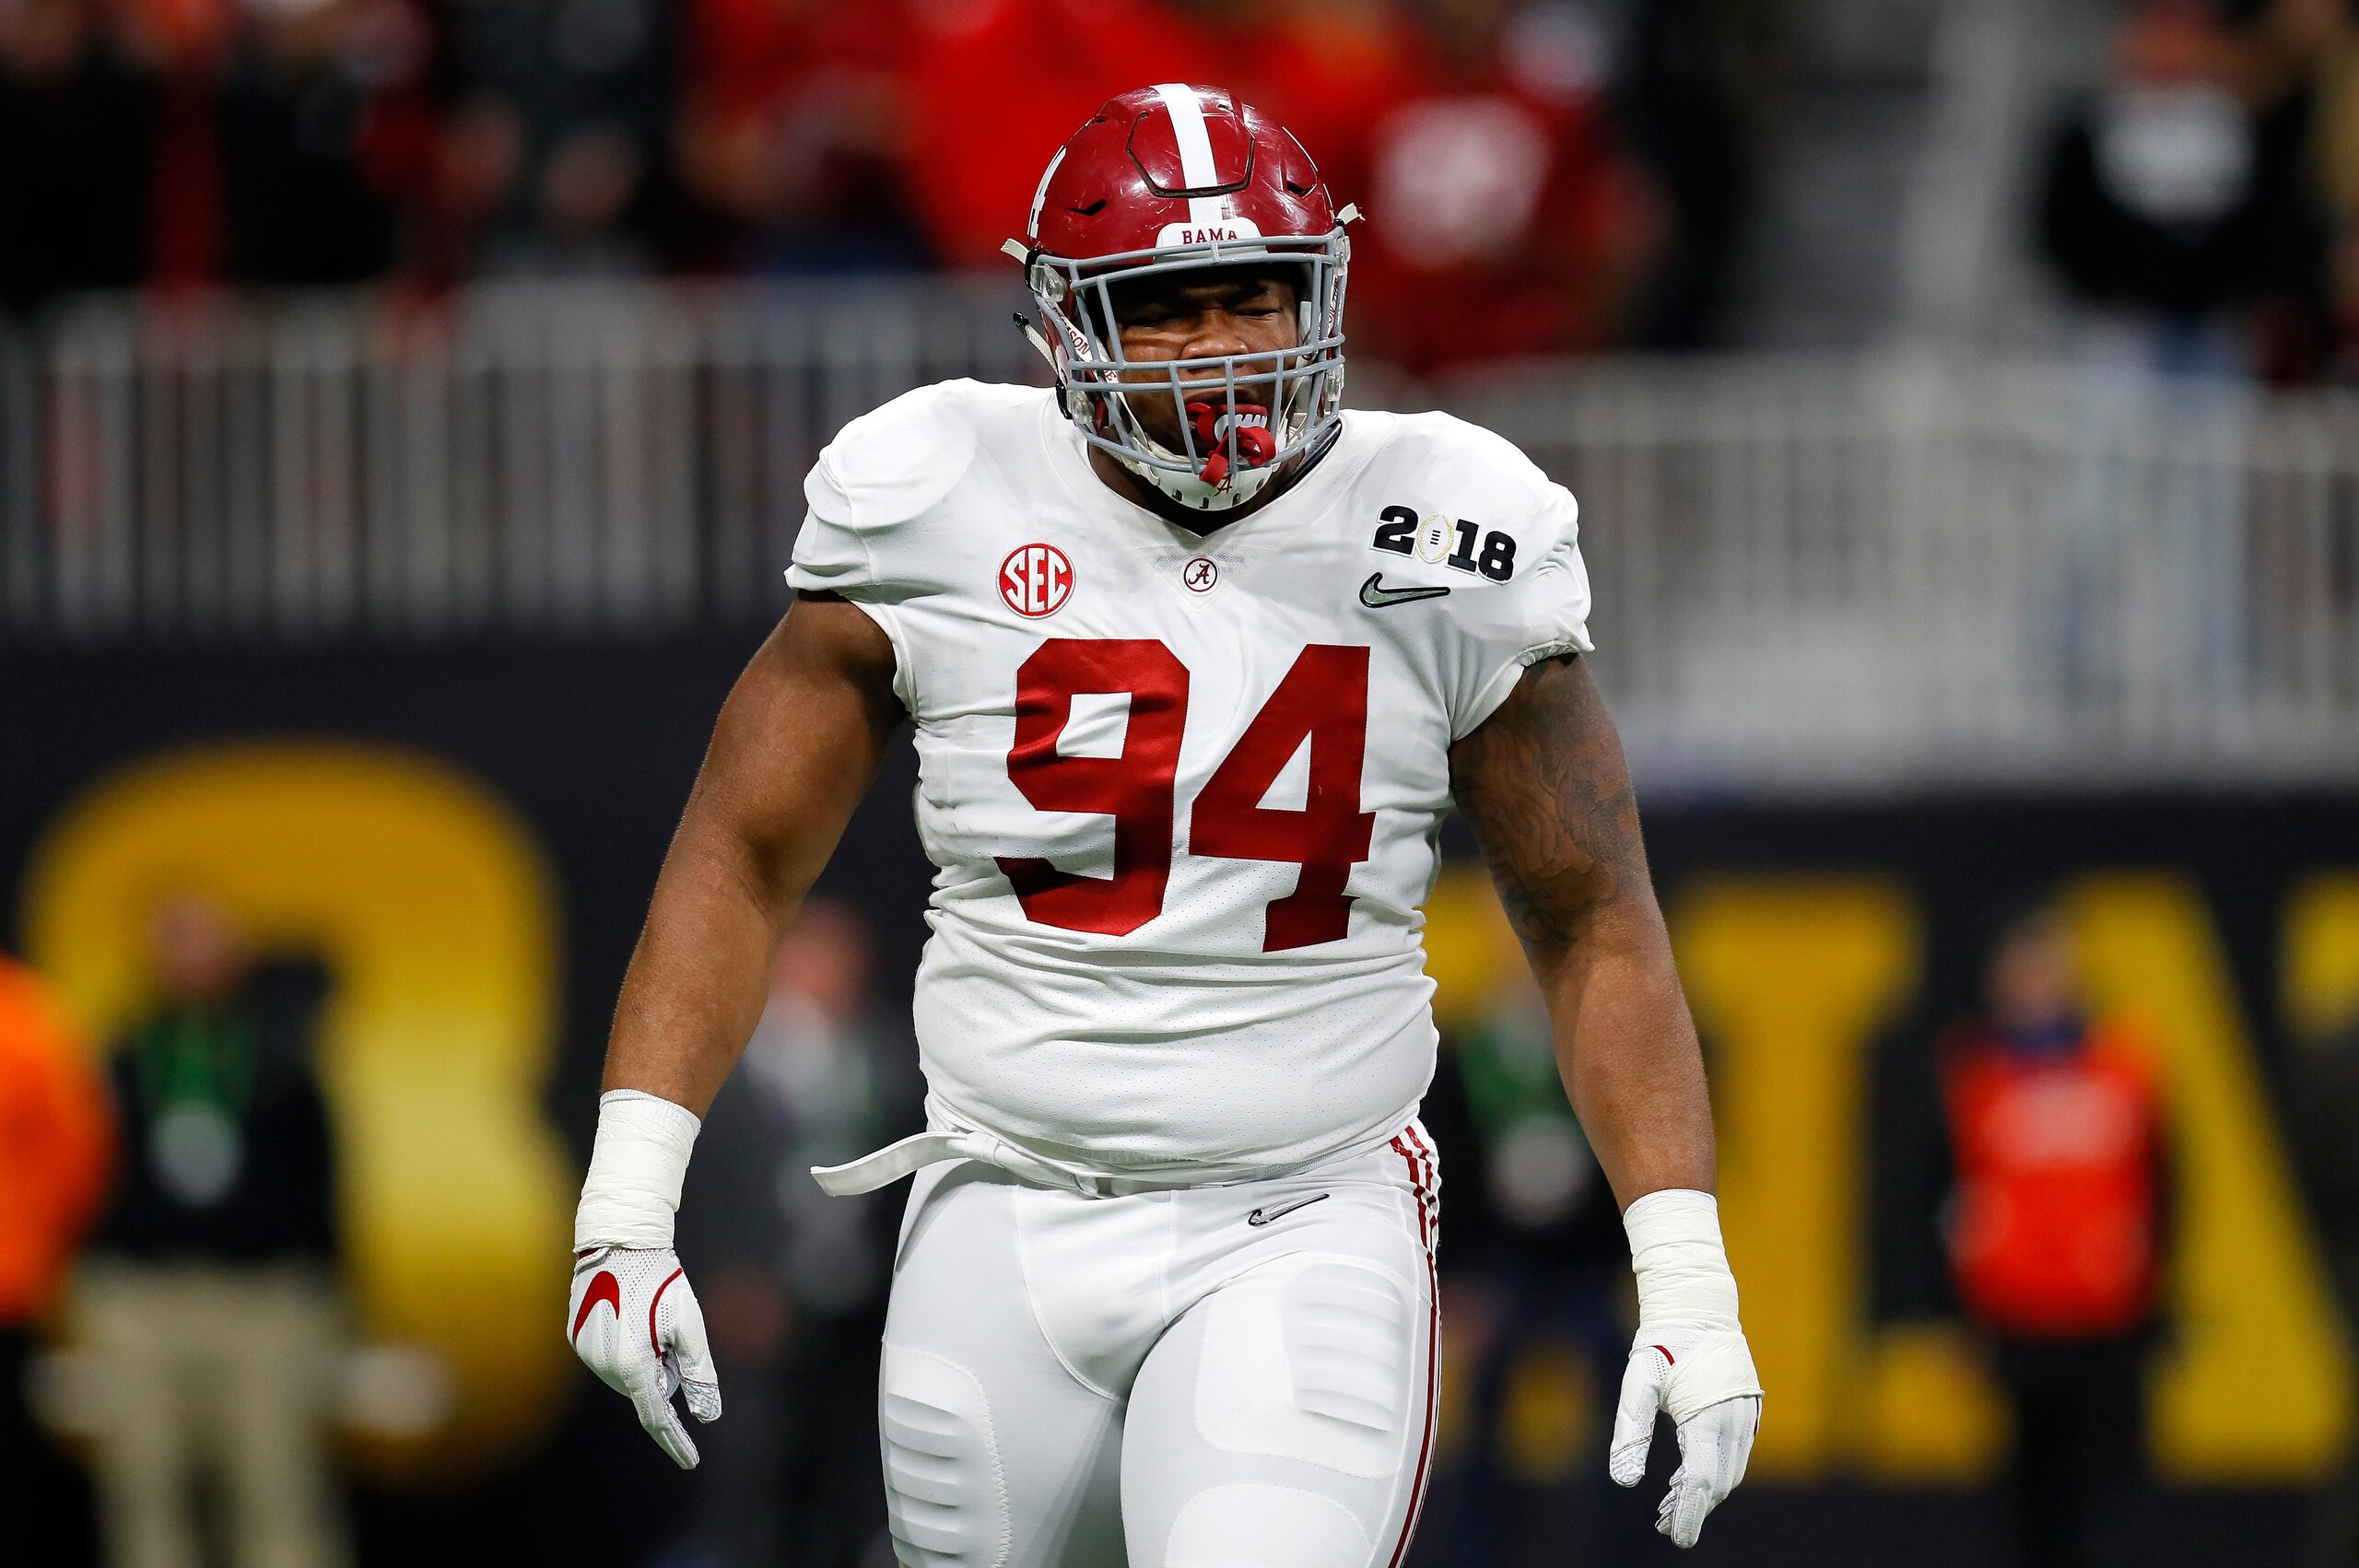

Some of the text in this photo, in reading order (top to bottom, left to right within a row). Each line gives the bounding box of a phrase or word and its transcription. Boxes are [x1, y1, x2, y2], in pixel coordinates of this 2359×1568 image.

[1181, 228, 1238, 245] BAMA
[1373, 505, 1517, 581] 2018
[1004, 547, 1068, 613] SEC
[993, 638, 1377, 953] 94
